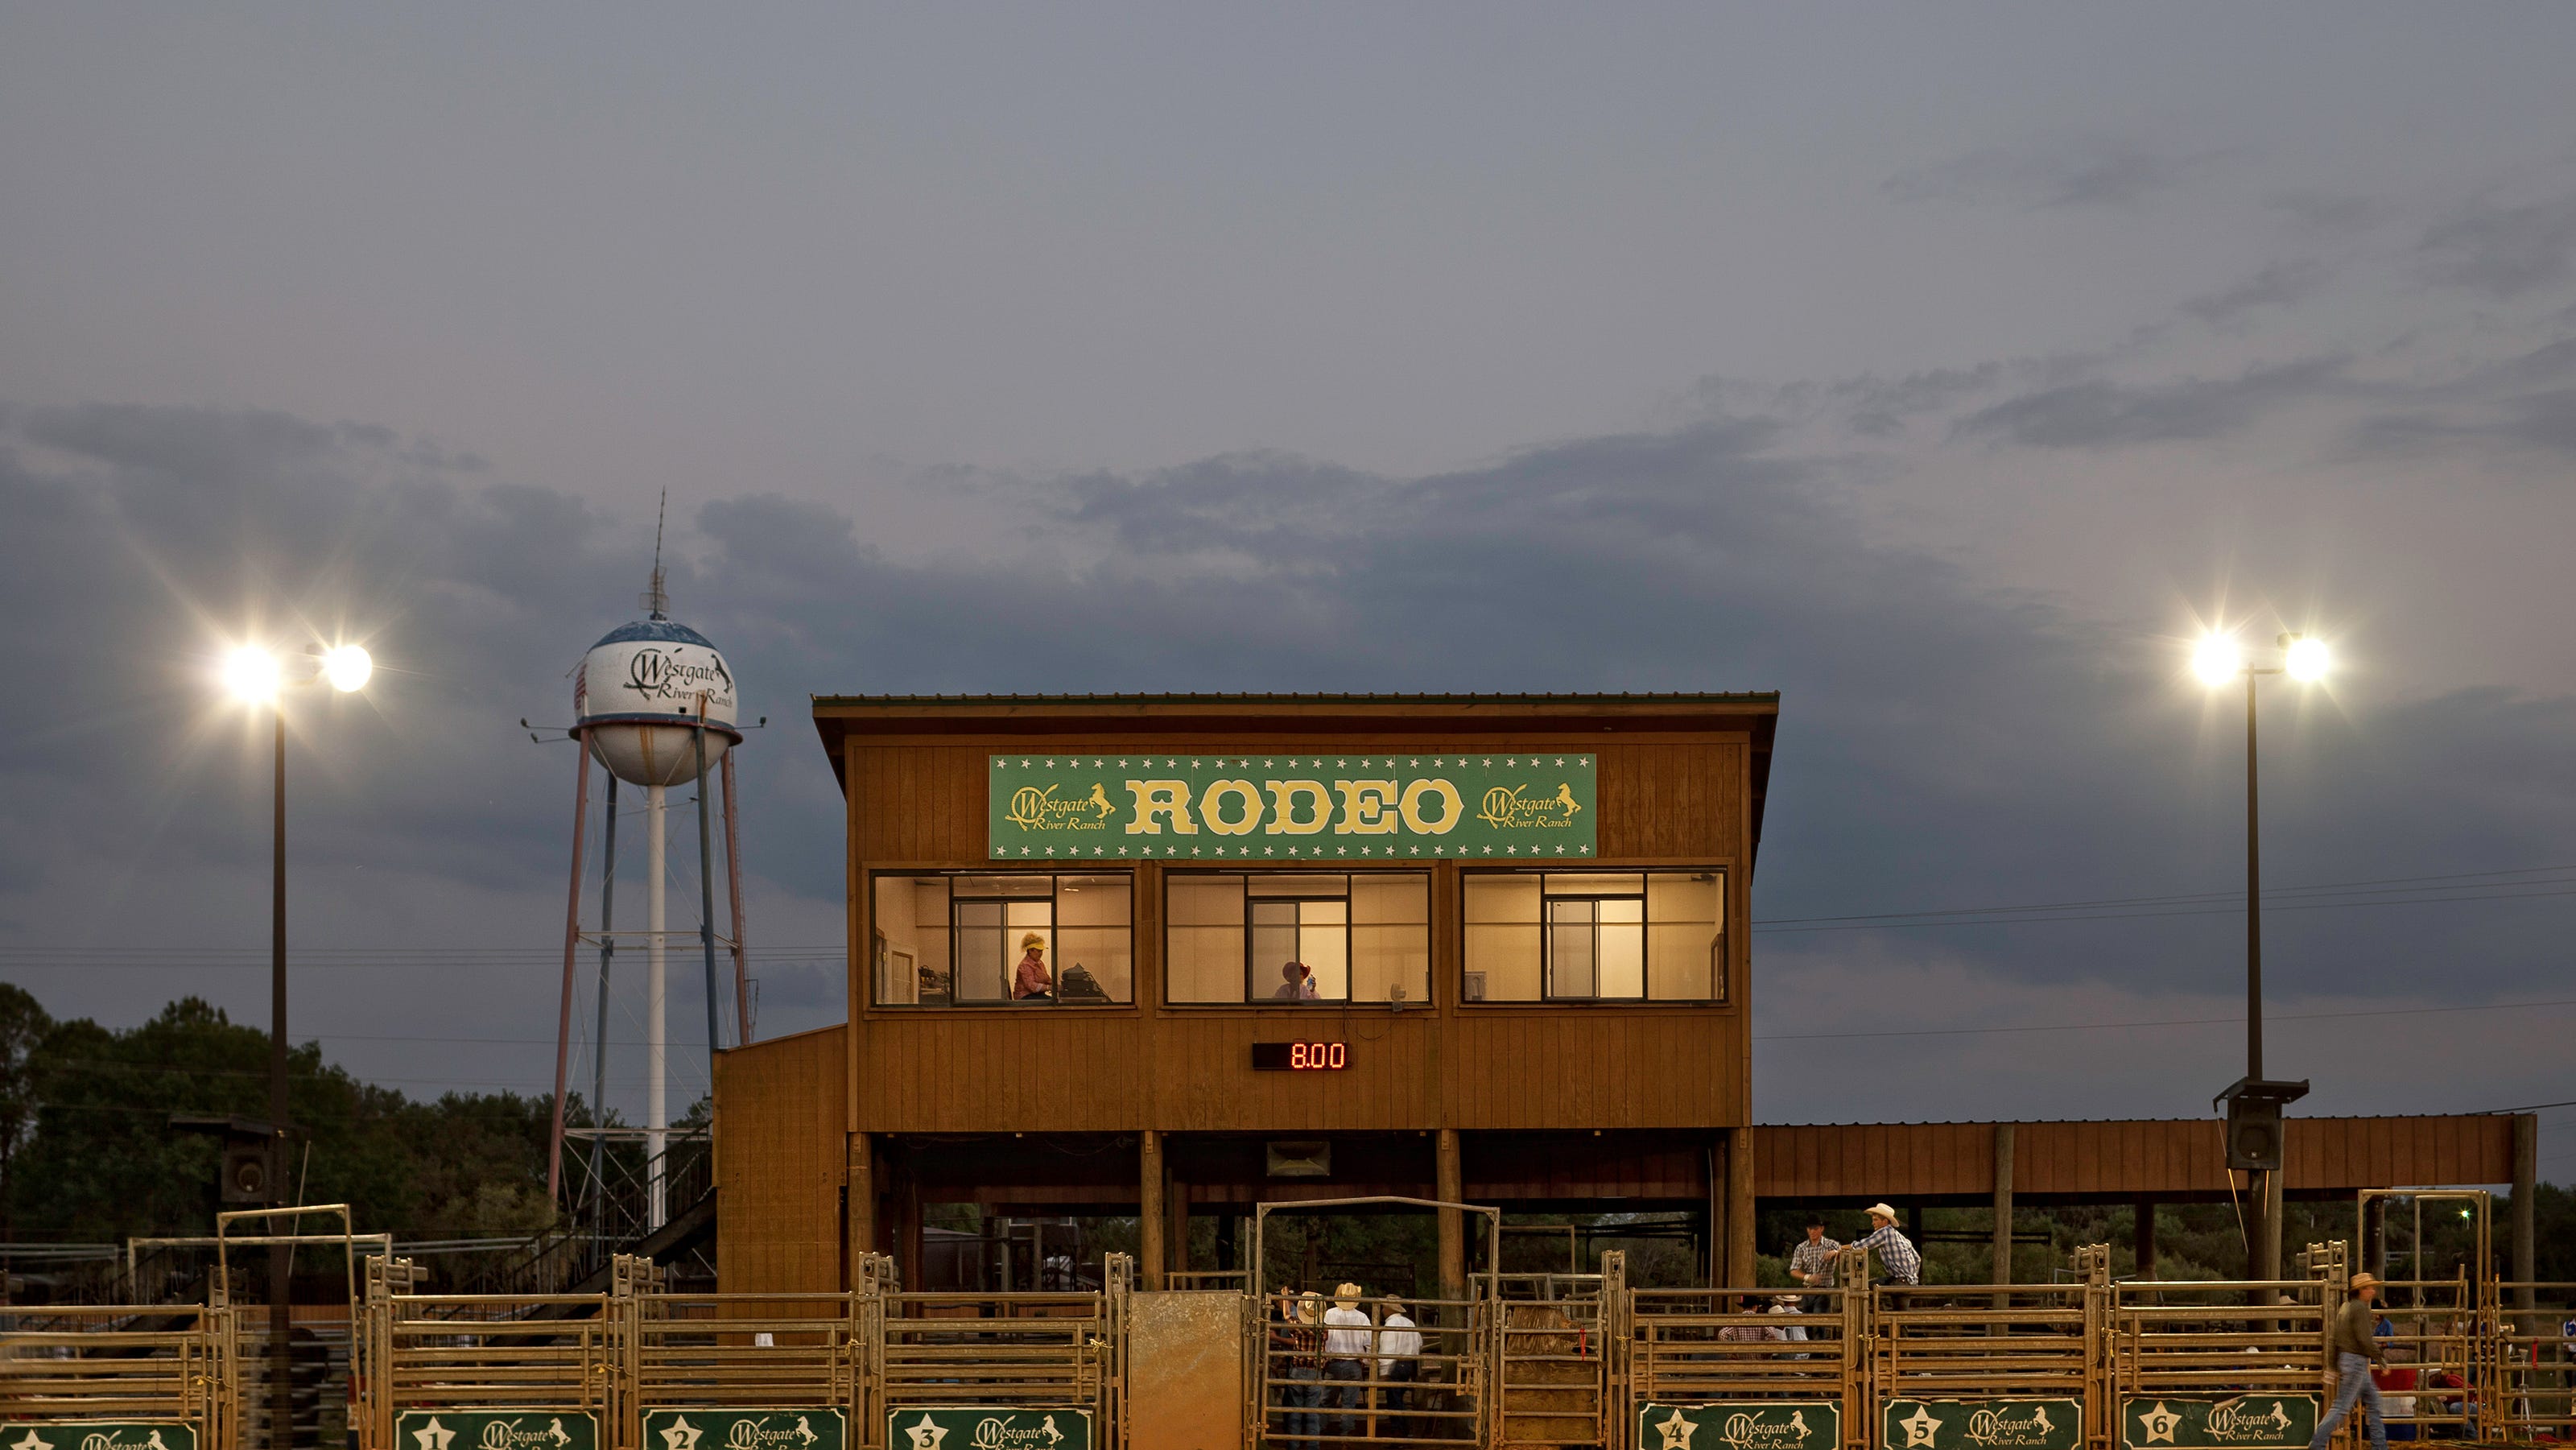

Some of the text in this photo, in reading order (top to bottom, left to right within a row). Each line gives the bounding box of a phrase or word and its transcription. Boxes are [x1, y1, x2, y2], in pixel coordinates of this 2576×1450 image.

[642, 654, 715, 686] Westgate
[657, 682, 733, 708] River Ranch
[1021, 792, 1088, 819] Westgate
[1125, 779, 1465, 836] RODEO
[1491, 792, 1555, 817] Westgate
[1032, 816, 1106, 830] River Ranch
[1502, 815, 1572, 828] River Ranch
[1291, 1043, 1344, 1068] 8.00
[1733, 1418, 1789, 1440] Westgate
[1913, 1420, 1930, 1440] 5
[1977, 1415, 2033, 1436] Westgate
[2152, 1415, 2169, 1435] 6
[2215, 1409, 2271, 1431] Westgate
[427, 1431, 439, 1450] 1
[491, 1426, 547, 1448] Westgate
[673, 1430, 689, 1449] 2
[738, 1424, 795, 1446] Westgate
[919, 1428, 935, 1448] 3
[985, 1423, 1042, 1444] Westgate
[1667, 1422, 1685, 1443] 4
[1988, 1435, 2047, 1446] River Ranch
[2225, 1429, 2285, 1441] River Ranch
[1743, 1439, 1804, 1450] River Ranch
